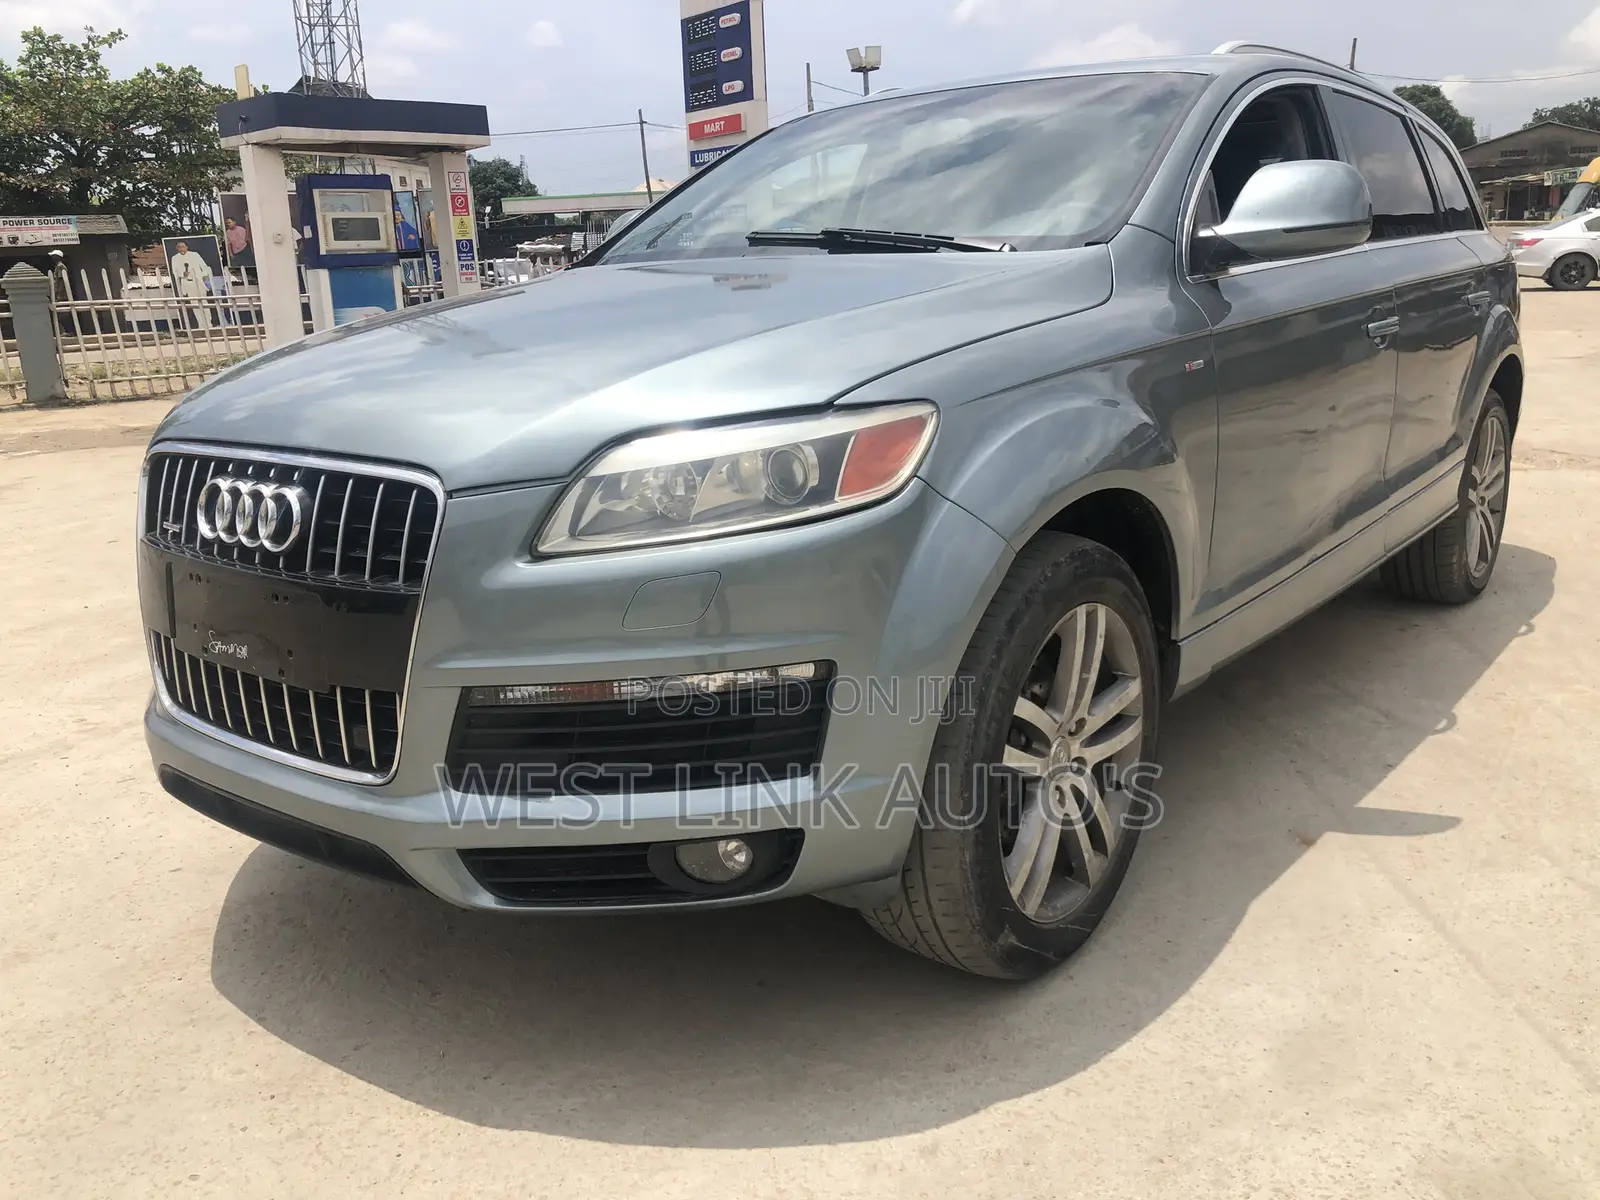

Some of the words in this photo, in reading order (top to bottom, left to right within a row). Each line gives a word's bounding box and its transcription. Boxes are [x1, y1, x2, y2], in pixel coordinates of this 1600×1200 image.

[721, 17, 737, 25] PETROL
[722, 50, 738, 59] DIESEL
[724, 84, 735, 92] LPG
[704, 121, 725, 134] MART
[694, 149, 731, 163] LUBRICA
[2, 219, 35, 227] POWER
[37, 218, 73, 226] SOURCE
[460, 263, 475, 271] POS
